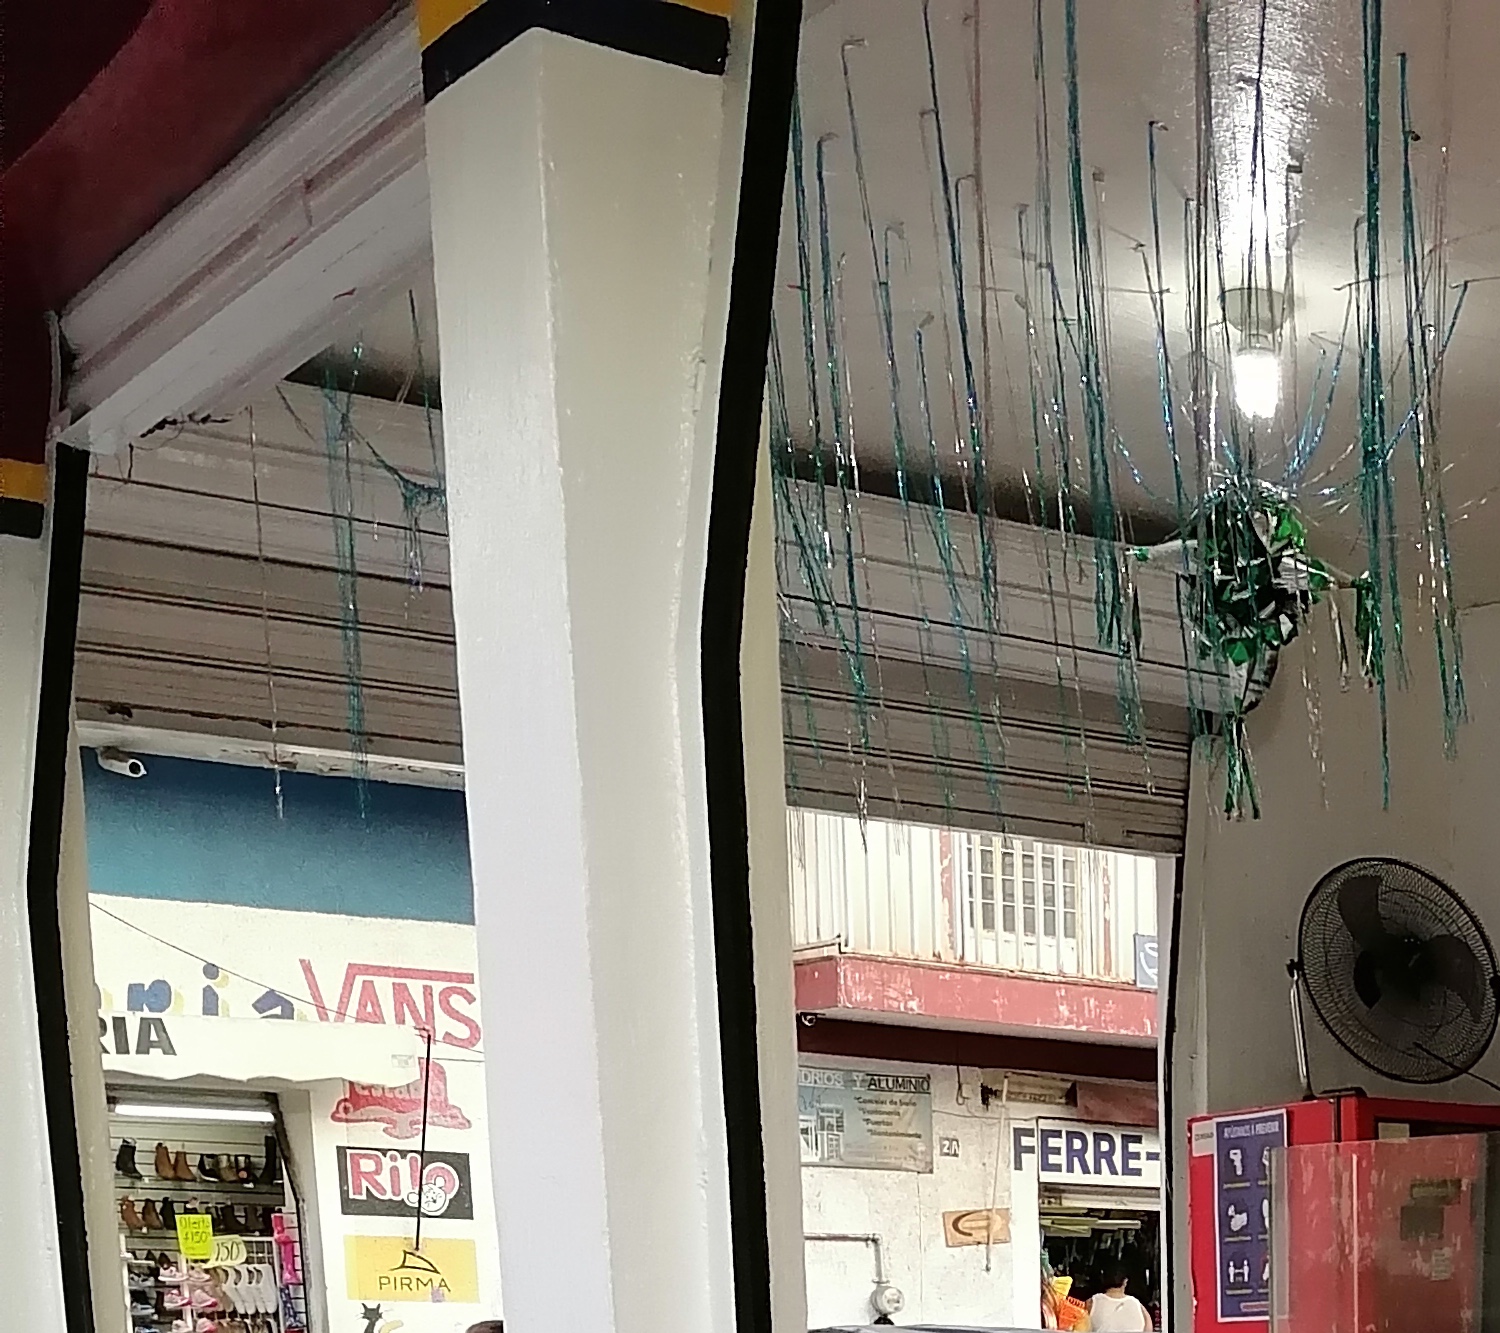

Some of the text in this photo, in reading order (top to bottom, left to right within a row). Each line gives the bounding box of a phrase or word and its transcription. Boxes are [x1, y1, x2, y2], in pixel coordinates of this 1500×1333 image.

[299, 958, 482, 1049] VANS
[867, 1077, 931, 1091] ALUMINIO
[378, 1275, 452, 1293] PIRMA
